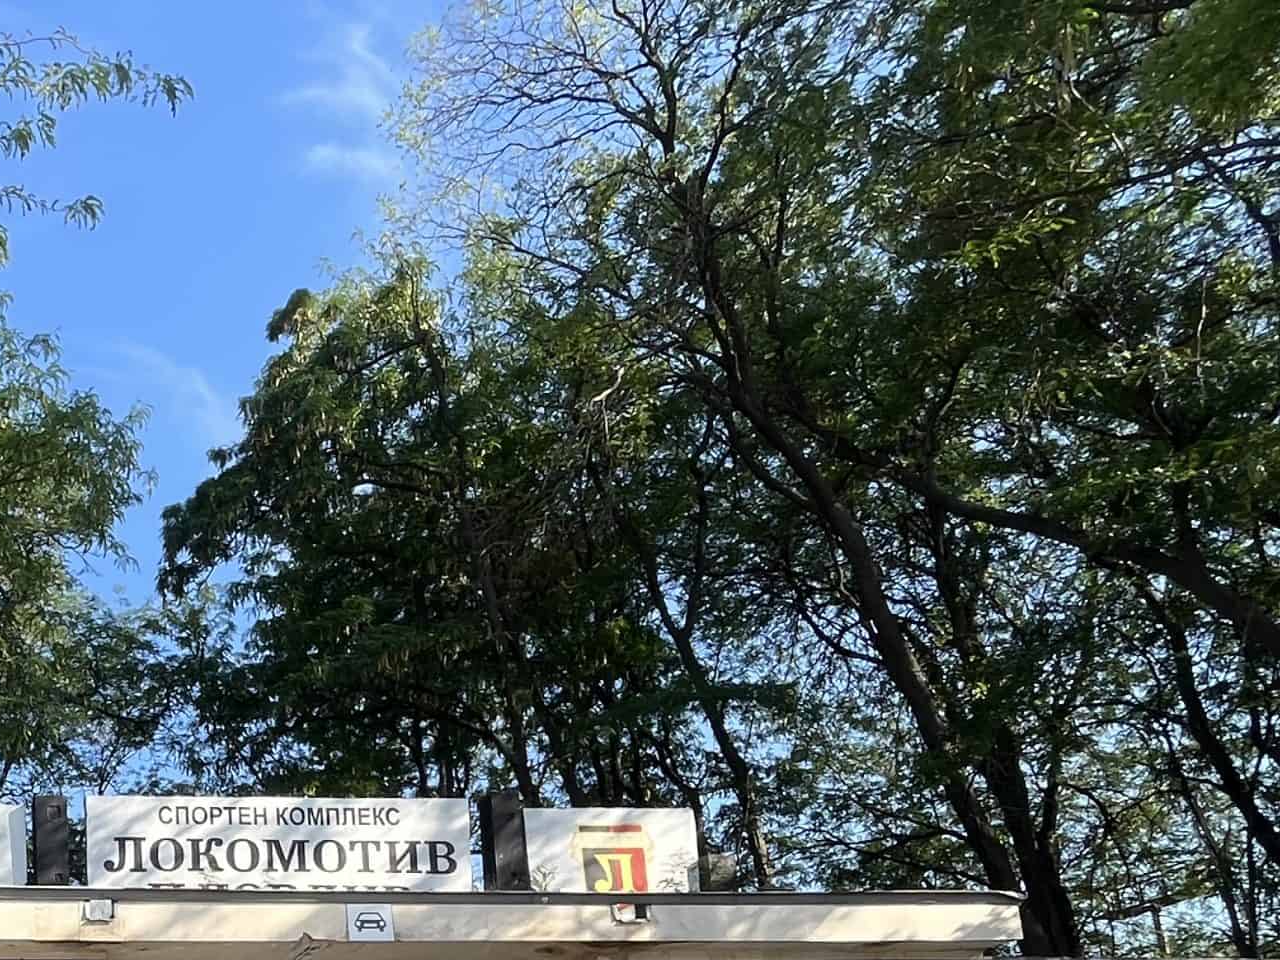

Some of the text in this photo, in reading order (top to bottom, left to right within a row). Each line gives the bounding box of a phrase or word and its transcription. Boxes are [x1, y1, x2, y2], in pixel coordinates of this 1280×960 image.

[158, 805, 401, 827] СПОРТЕН КОМПЛЕКС
[102, 836, 458, 875] ЛОКОМОТИВ
